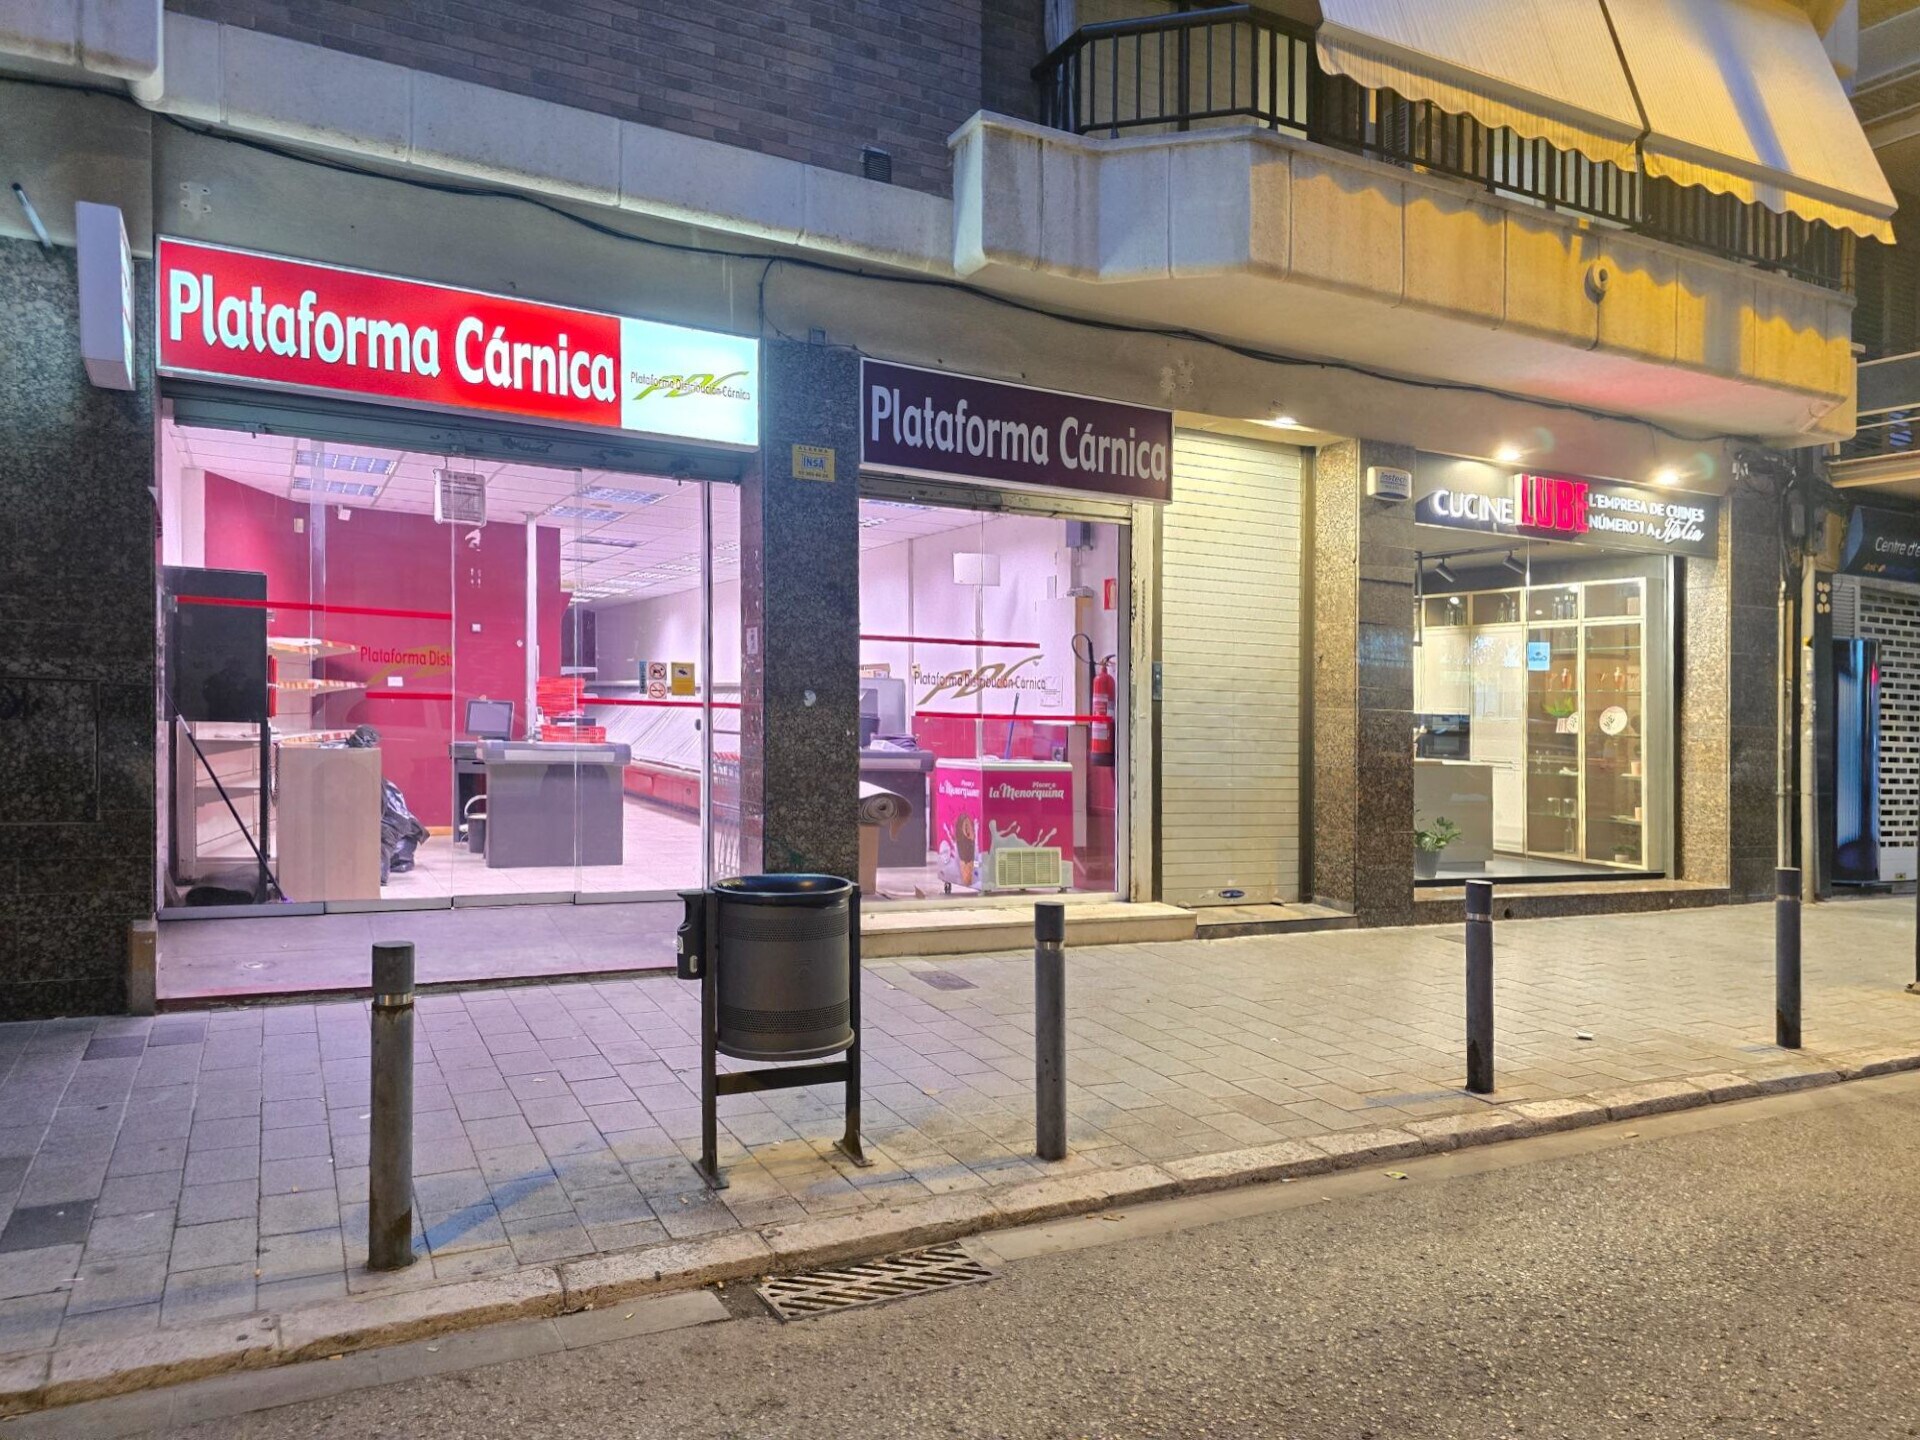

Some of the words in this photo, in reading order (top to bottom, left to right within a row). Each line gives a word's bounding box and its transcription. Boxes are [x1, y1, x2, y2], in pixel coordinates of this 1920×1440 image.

[169, 268, 441, 378] Plataforma
[455, 316, 616, 403] Cárnica
[630, 371, 674, 389] Plataforma
[871, 385, 1049, 466] Plataforma
[1059, 416, 1167, 481] Cárnica
[1432, 489, 1514, 524] CUCINE
[1521, 473, 1589, 533] LUBE
[1588, 493, 1649, 514] L'EMPRESA
[1649, 502, 1665, 516] DE
[1588, 513, 1638, 534] NÚMERO
[1639, 520, 1645, 535] 1
[1646, 522, 1656, 537] A
[1655, 517, 1705, 544] Italia
[1875, 536, 1907, 555] Centre
[360, 646, 426, 666] Plataforma
[429, 650, 453, 667] Dist
[914, 670, 962, 687] Plataforma
[988, 786, 999, 799] la
[1000, 782, 1065, 801] Menorquina
